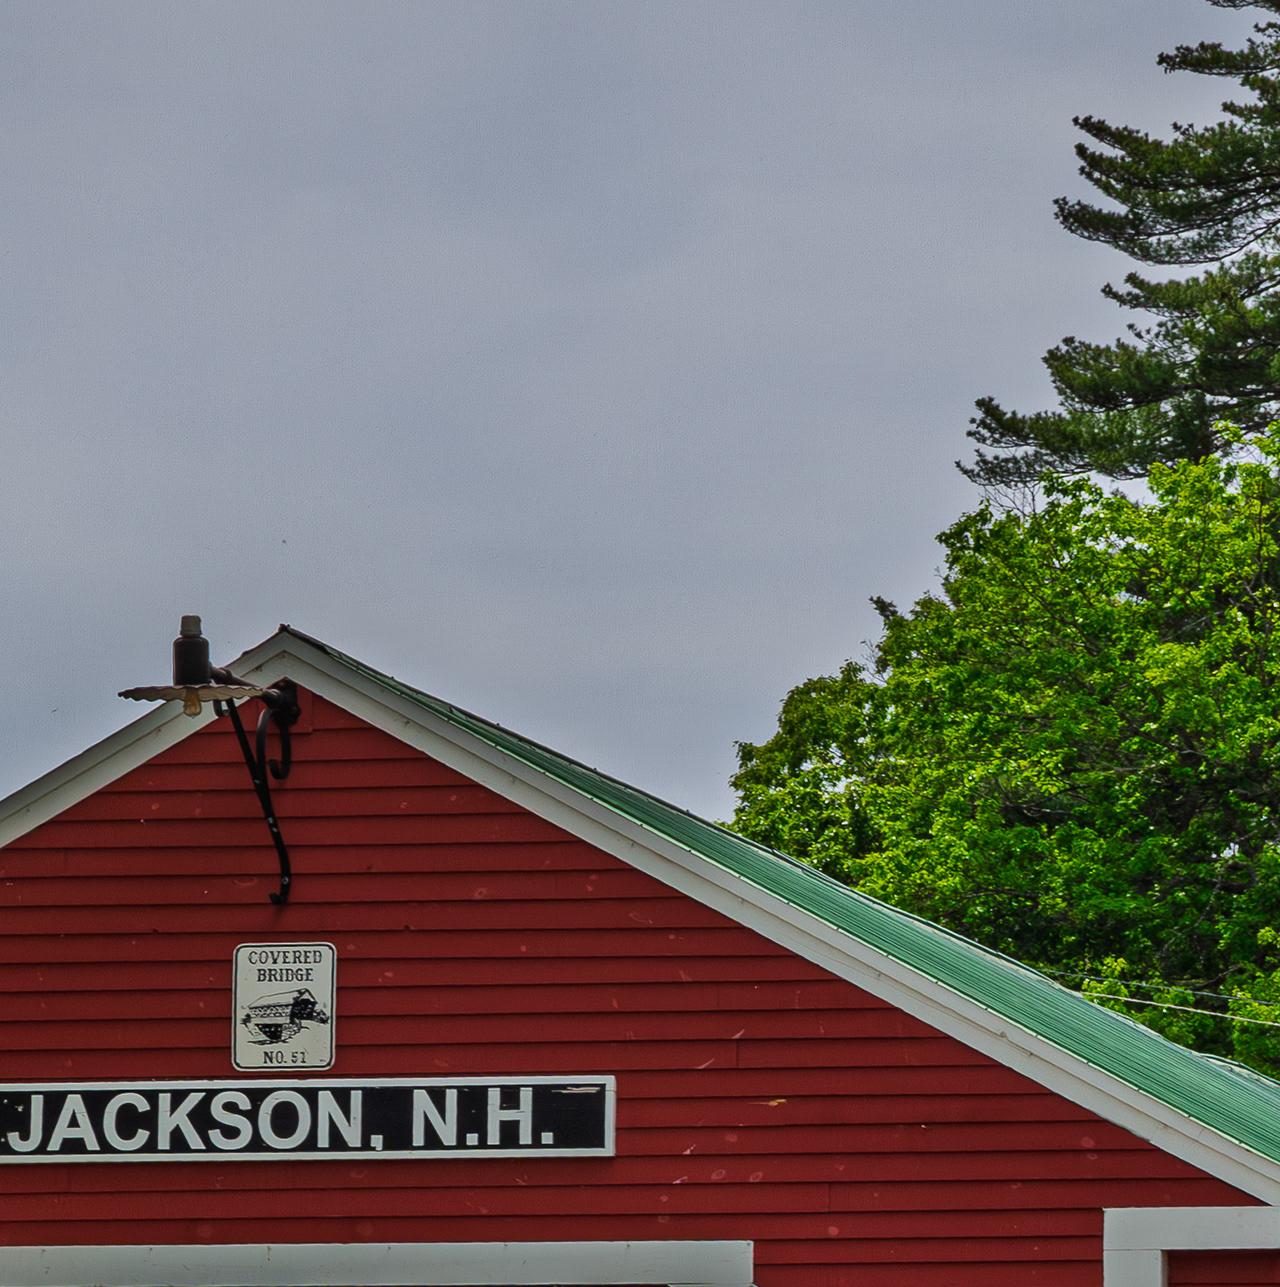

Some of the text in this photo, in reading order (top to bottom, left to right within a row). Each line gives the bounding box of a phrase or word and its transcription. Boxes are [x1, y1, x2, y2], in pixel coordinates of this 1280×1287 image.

[248, 950, 322, 965] COVERED
[257, 968, 314, 982] BRIDGE
[263, 1051, 307, 1064] NO. 51
[6, 1087, 555, 1152] JACKSON, N.H.
